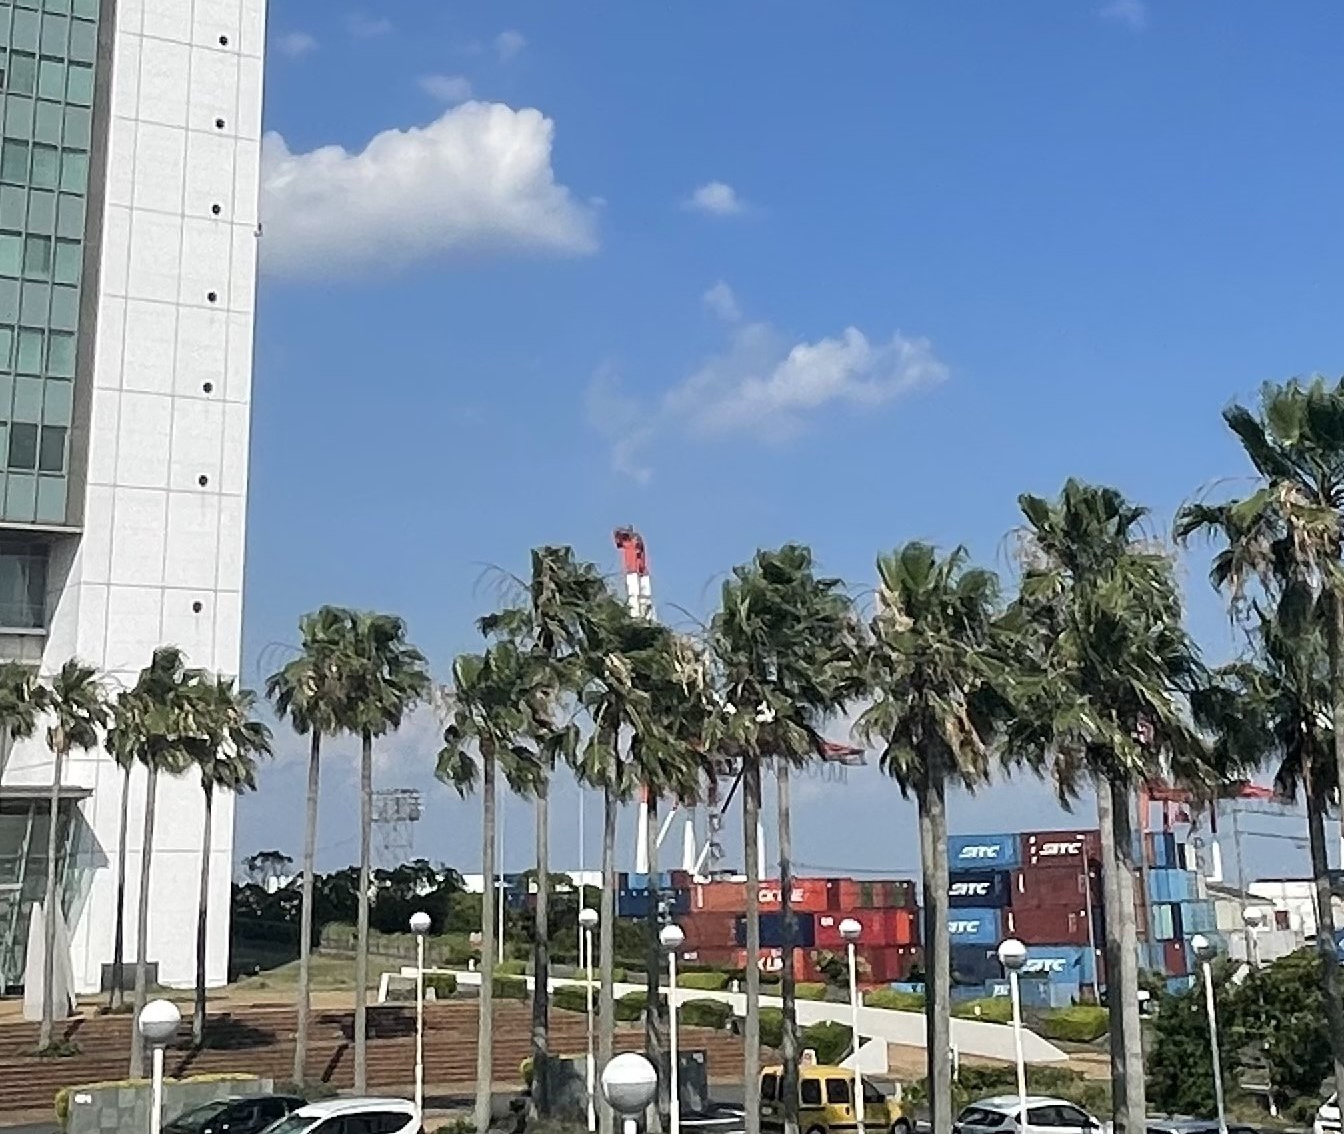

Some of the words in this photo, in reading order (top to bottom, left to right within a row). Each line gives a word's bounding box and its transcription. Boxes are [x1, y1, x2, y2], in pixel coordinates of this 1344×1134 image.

[959, 844, 1000, 858] SITC
[1039, 842, 1082, 856] SITC
[949, 882, 991, 896] SITC
